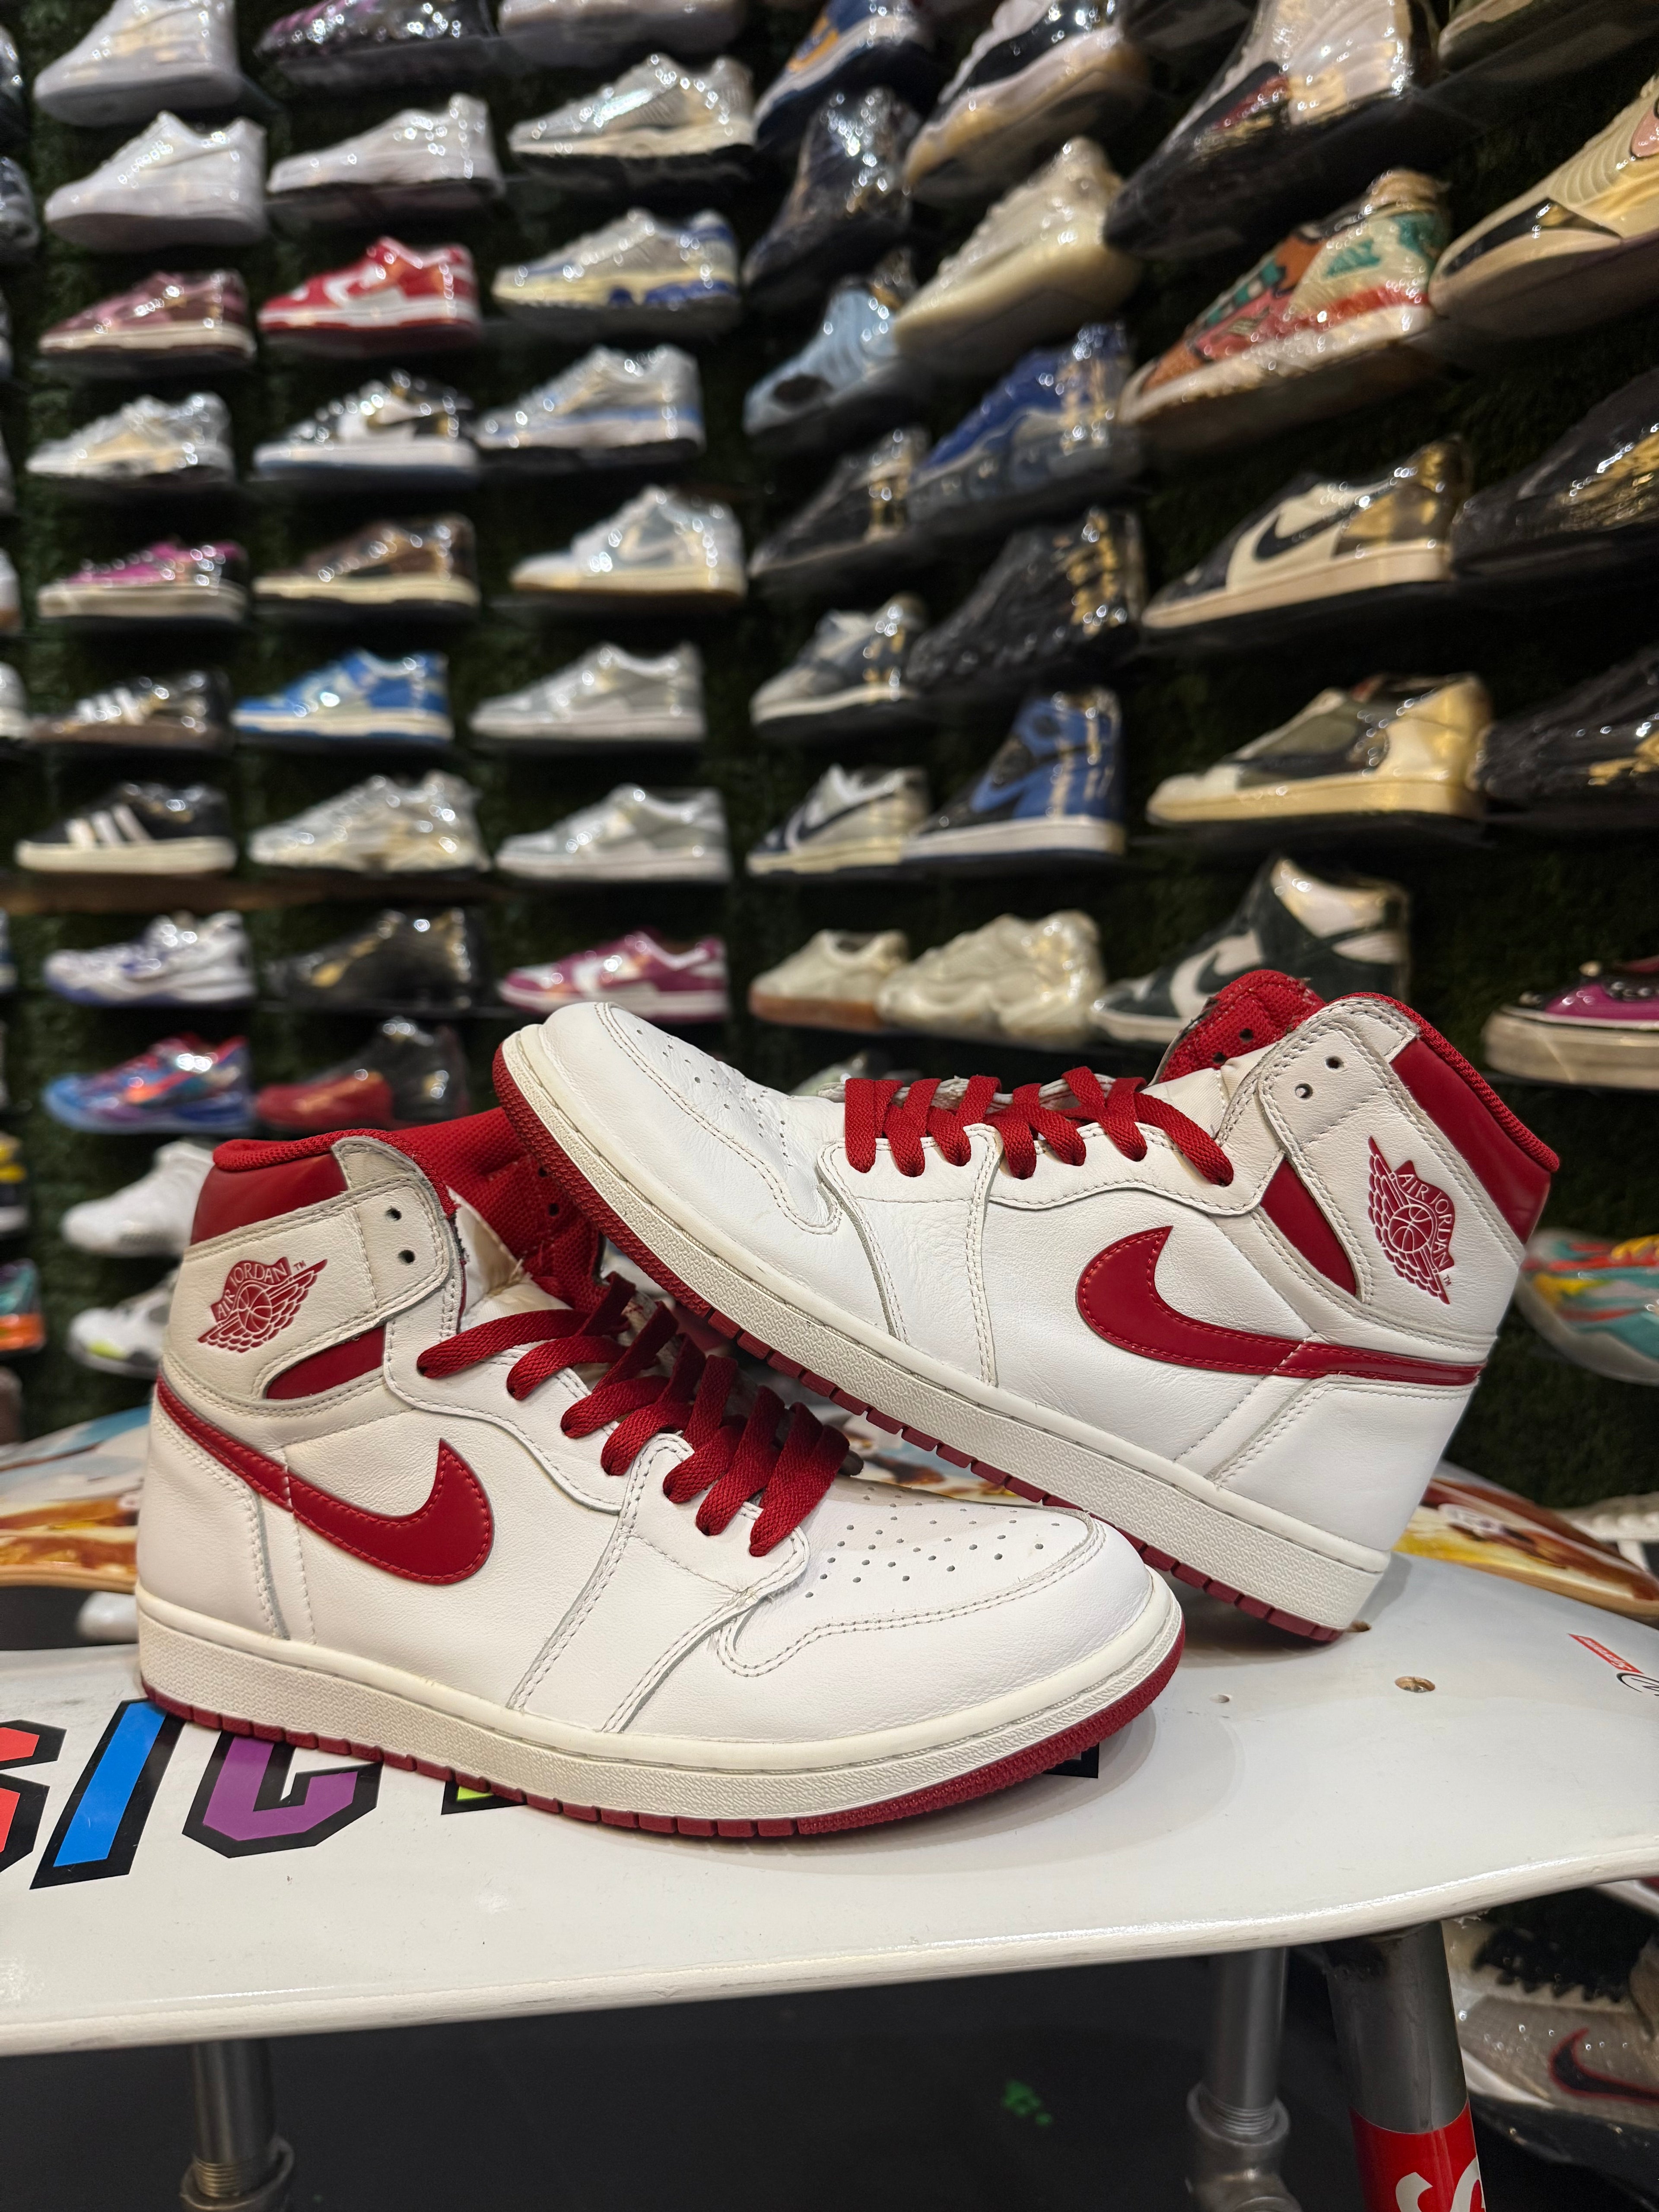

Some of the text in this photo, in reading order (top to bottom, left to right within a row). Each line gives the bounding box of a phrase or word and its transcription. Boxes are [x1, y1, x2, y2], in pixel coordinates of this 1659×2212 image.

[1398, 1174, 1428, 1201] AIR
[1429, 1192, 1452, 1267] JORDAN
[218, 1289, 235, 1319] AIR
[229, 1262, 287, 1287] JORDAN
